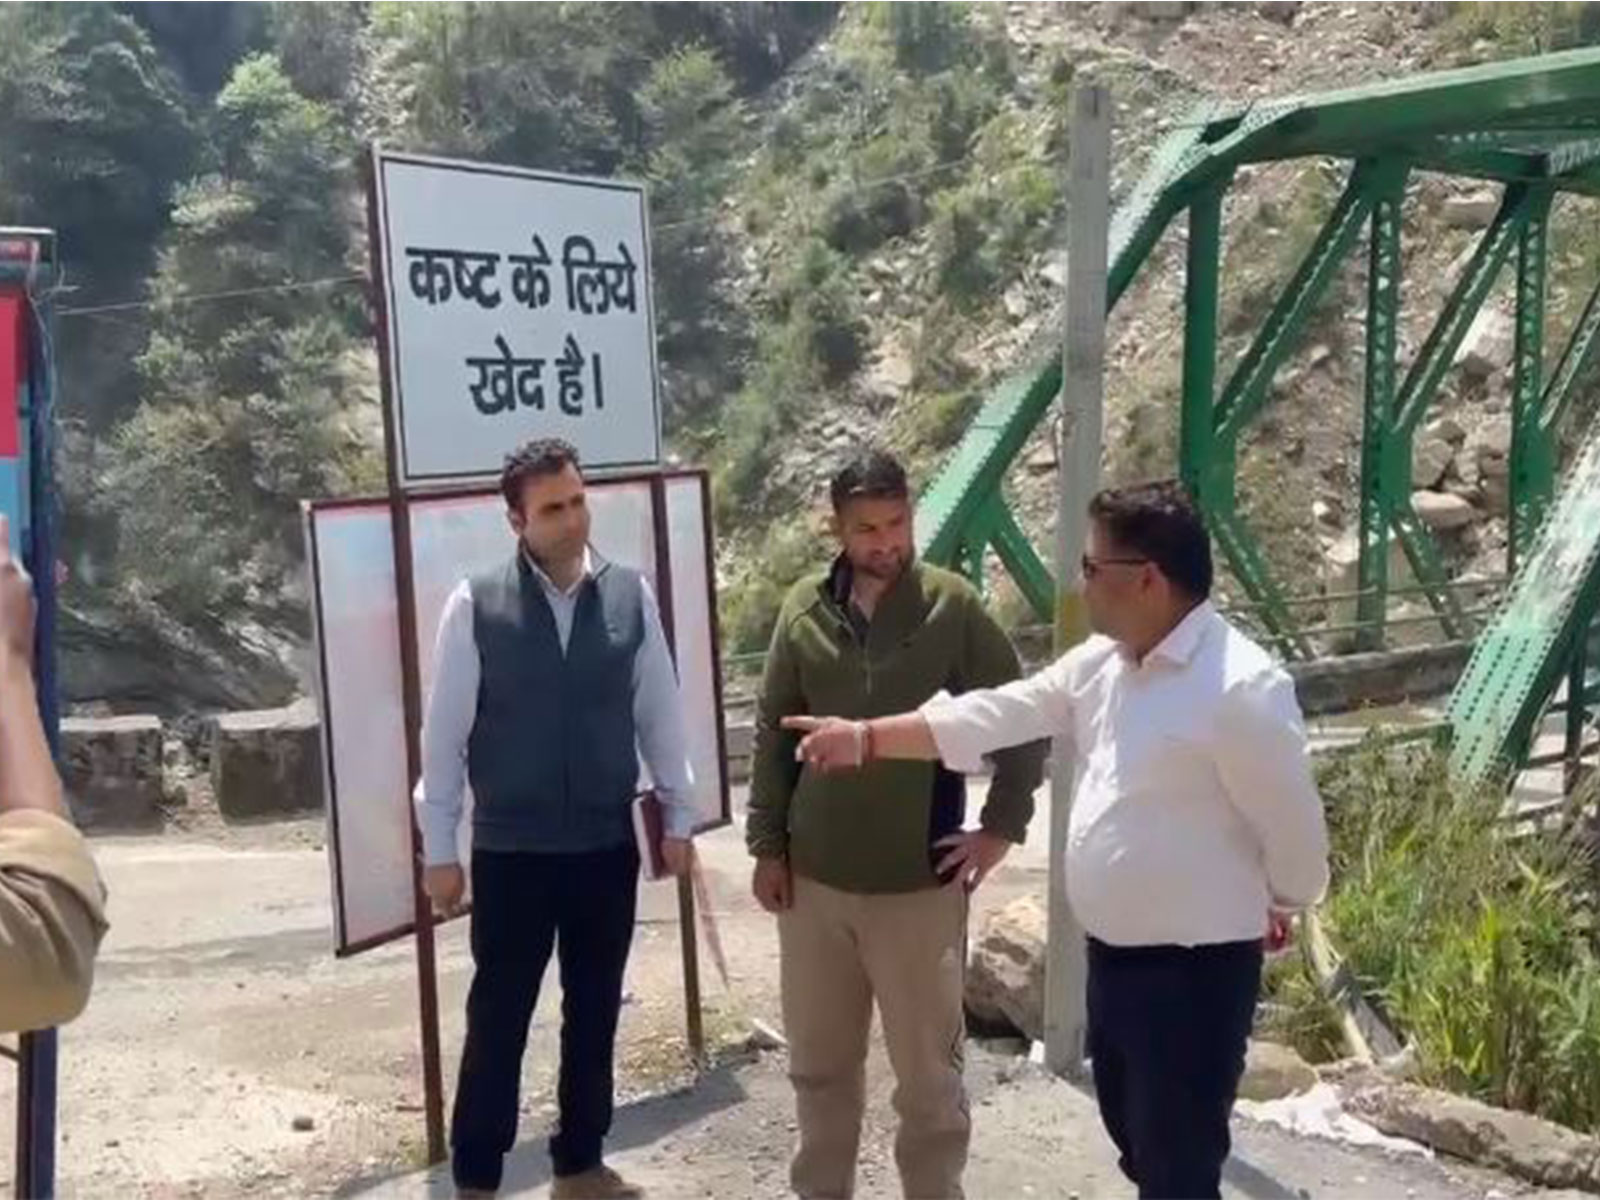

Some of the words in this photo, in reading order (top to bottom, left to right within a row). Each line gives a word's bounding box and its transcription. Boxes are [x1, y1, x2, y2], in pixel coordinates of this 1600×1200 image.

[405, 246, 501, 310] कष्ट
[507, 233, 552, 309] के
[562, 235, 637, 315] लिये
[465, 333, 547, 416] खेद
